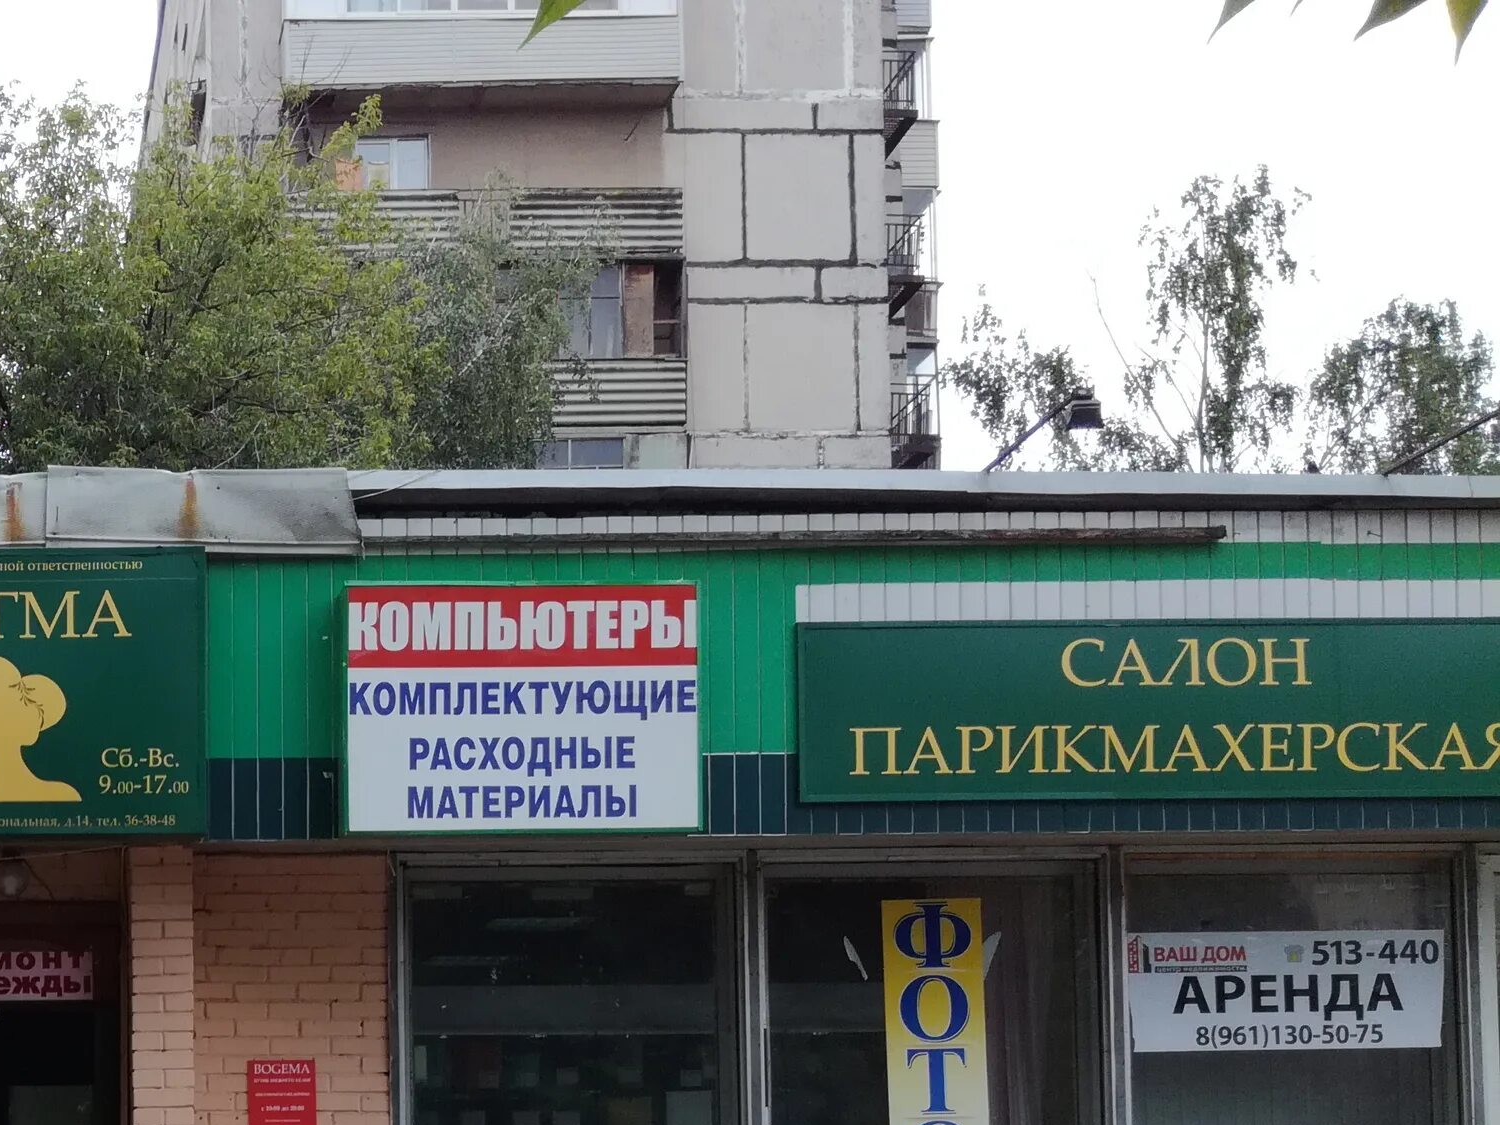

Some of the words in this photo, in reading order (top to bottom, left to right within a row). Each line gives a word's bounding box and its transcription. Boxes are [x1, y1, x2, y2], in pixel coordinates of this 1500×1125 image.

[27, 560, 143, 573] ответственностью
[349, 600, 697, 651] КОМПЬЮТЕРЫ
[1061, 638, 1312, 687] САЛОН
[349, 680, 696, 720] КОМПЛЕКТУЮЩИЕ
[101, 747, 180, 768] Сб.-Вс.
[409, 736, 636, 777] РАСХОДНЫЕ
[407, 784, 637, 819] МАТЕРИАЛЫ
[96, 817, 121, 827] тел.
[124, 815, 176, 827] 36-38-48
[1154, 946, 1197, 962] ВАШ
[1201, 945, 1246, 963] ДОМ
[1312, 938, 1439, 966] 513-440
[1173, 973, 1404, 1021] АРЕНДА
[1195, 1024, 1384, 1049] 8(961)130-50-75
[254, 1063, 310, 1074] BOGEMA
